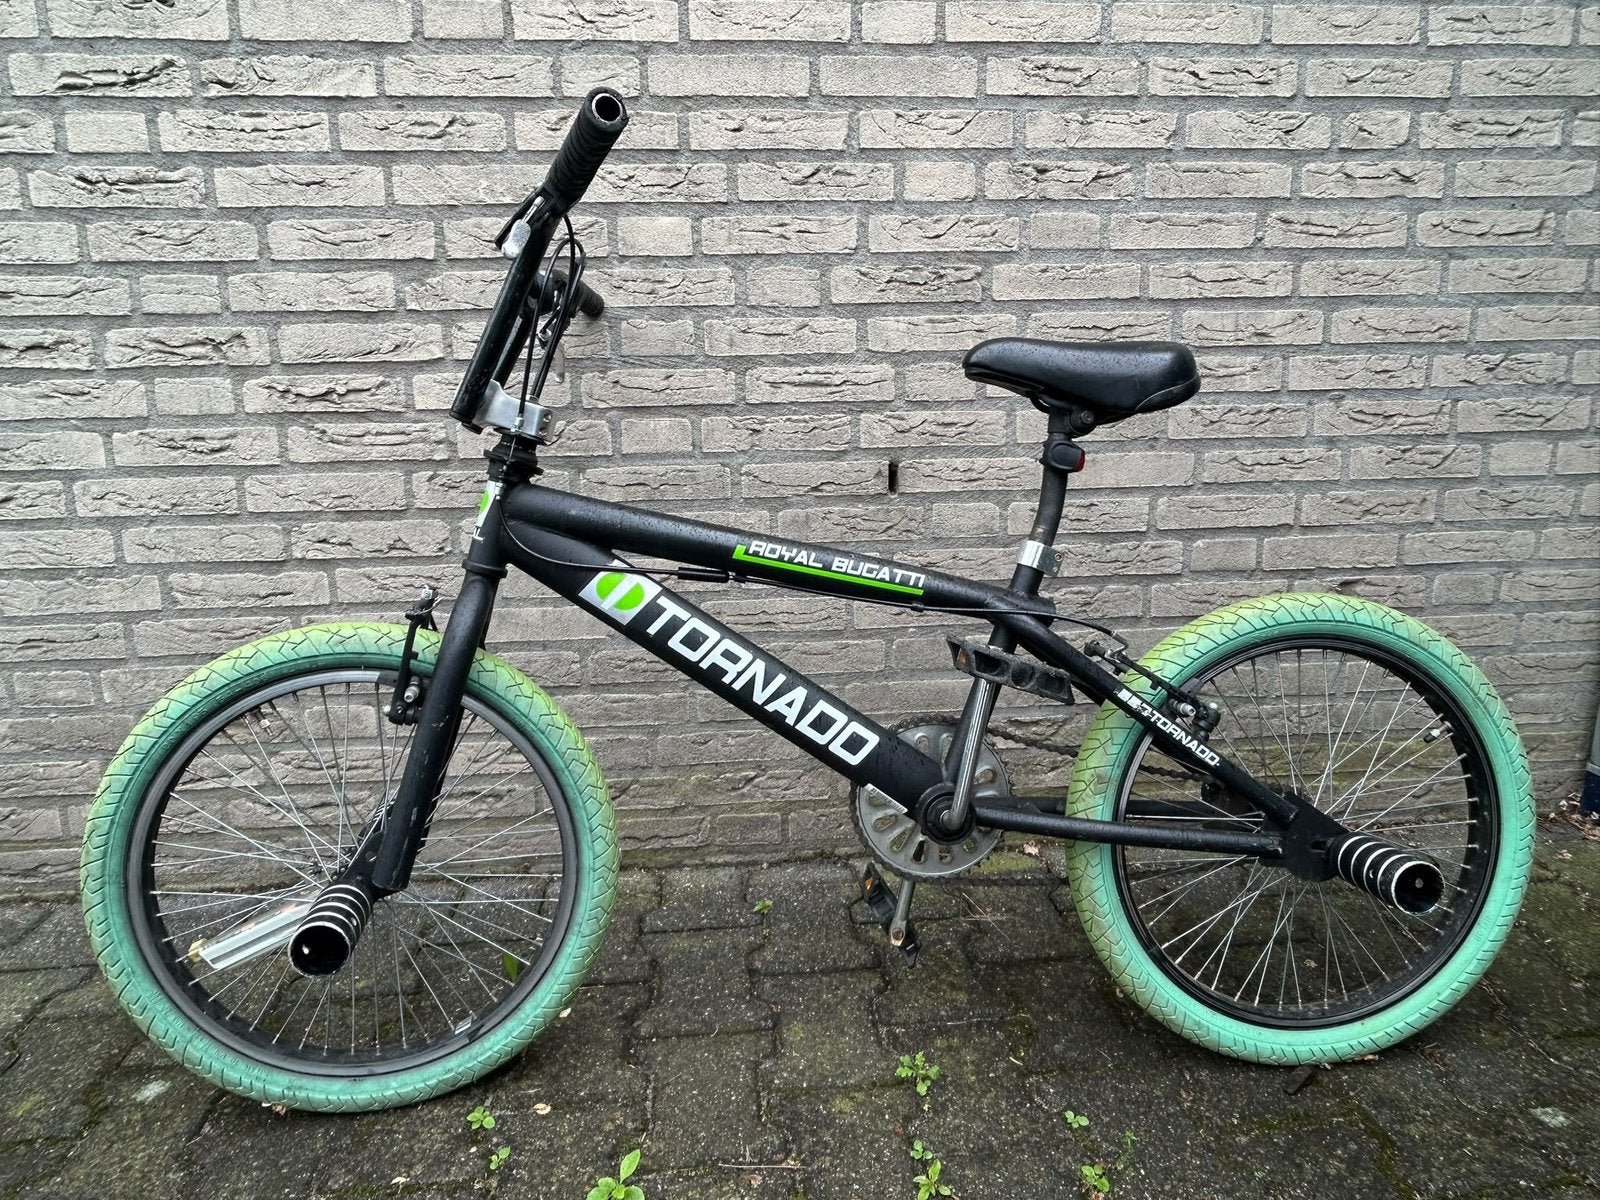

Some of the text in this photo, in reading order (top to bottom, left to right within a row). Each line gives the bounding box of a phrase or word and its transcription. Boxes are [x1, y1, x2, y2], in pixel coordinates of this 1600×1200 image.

[749, 540, 926, 588] ROYAL BUGATTI
[646, 595, 880, 766] TORNADO
